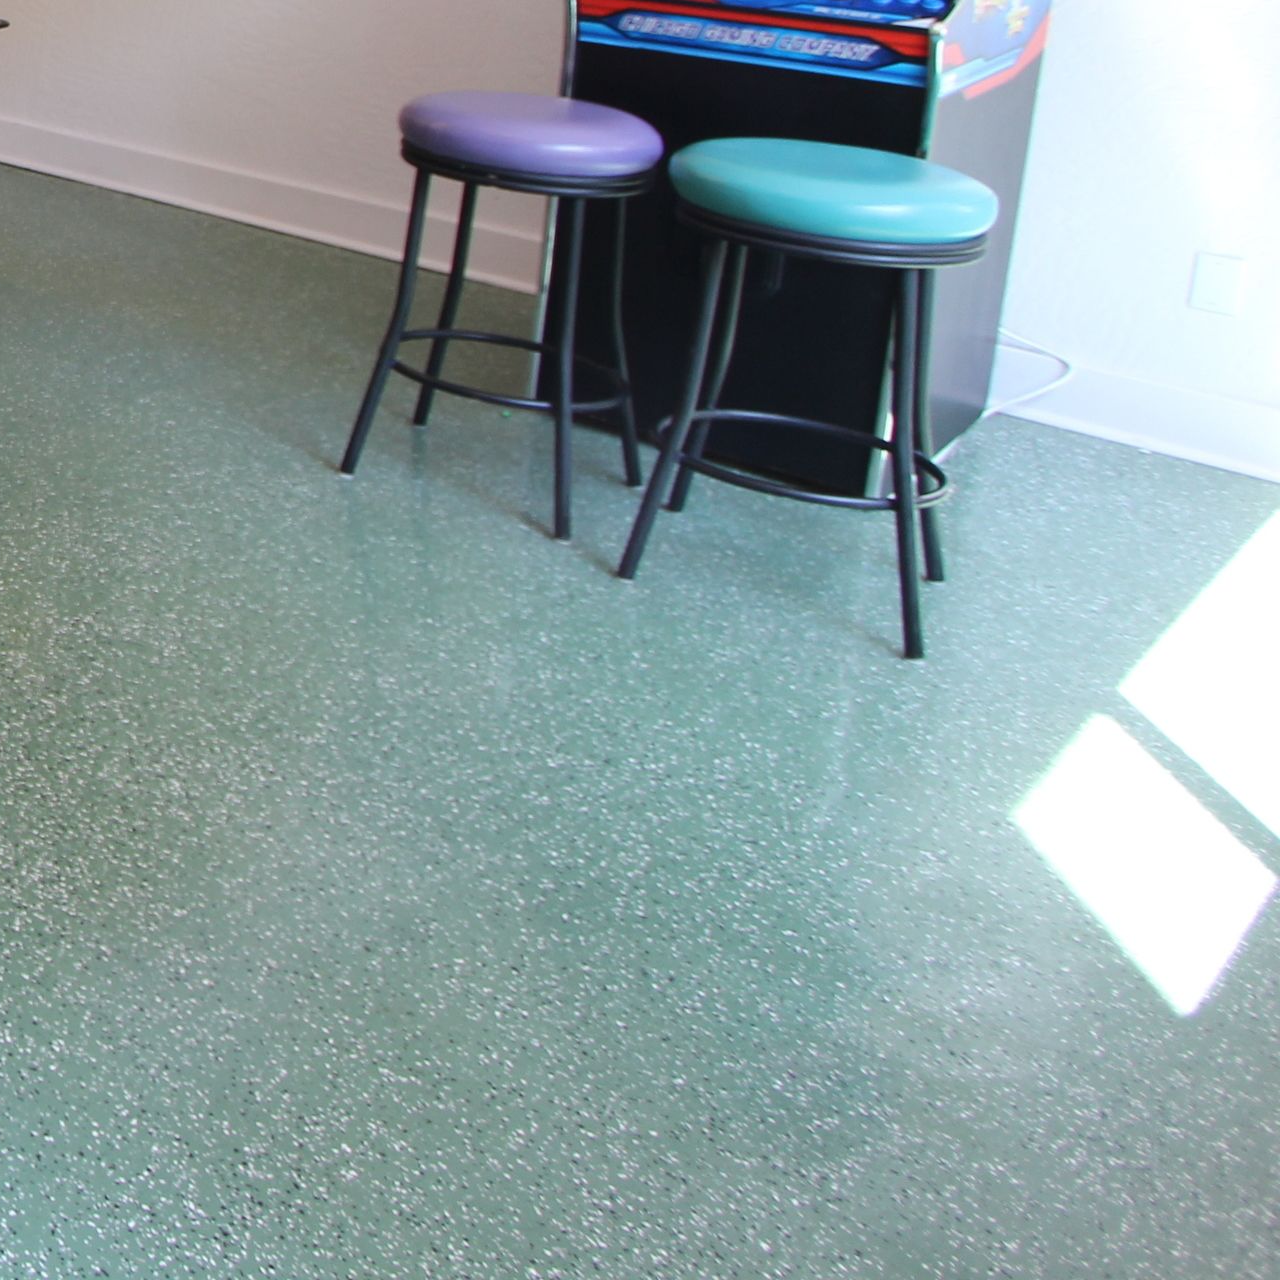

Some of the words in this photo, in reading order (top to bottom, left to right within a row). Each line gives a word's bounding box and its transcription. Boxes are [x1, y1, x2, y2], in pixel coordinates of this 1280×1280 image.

[619, 14, 699, 39] CHICAGO
[703, 25, 776, 48] GAMING
[778, 35, 880, 62] COMPANY
